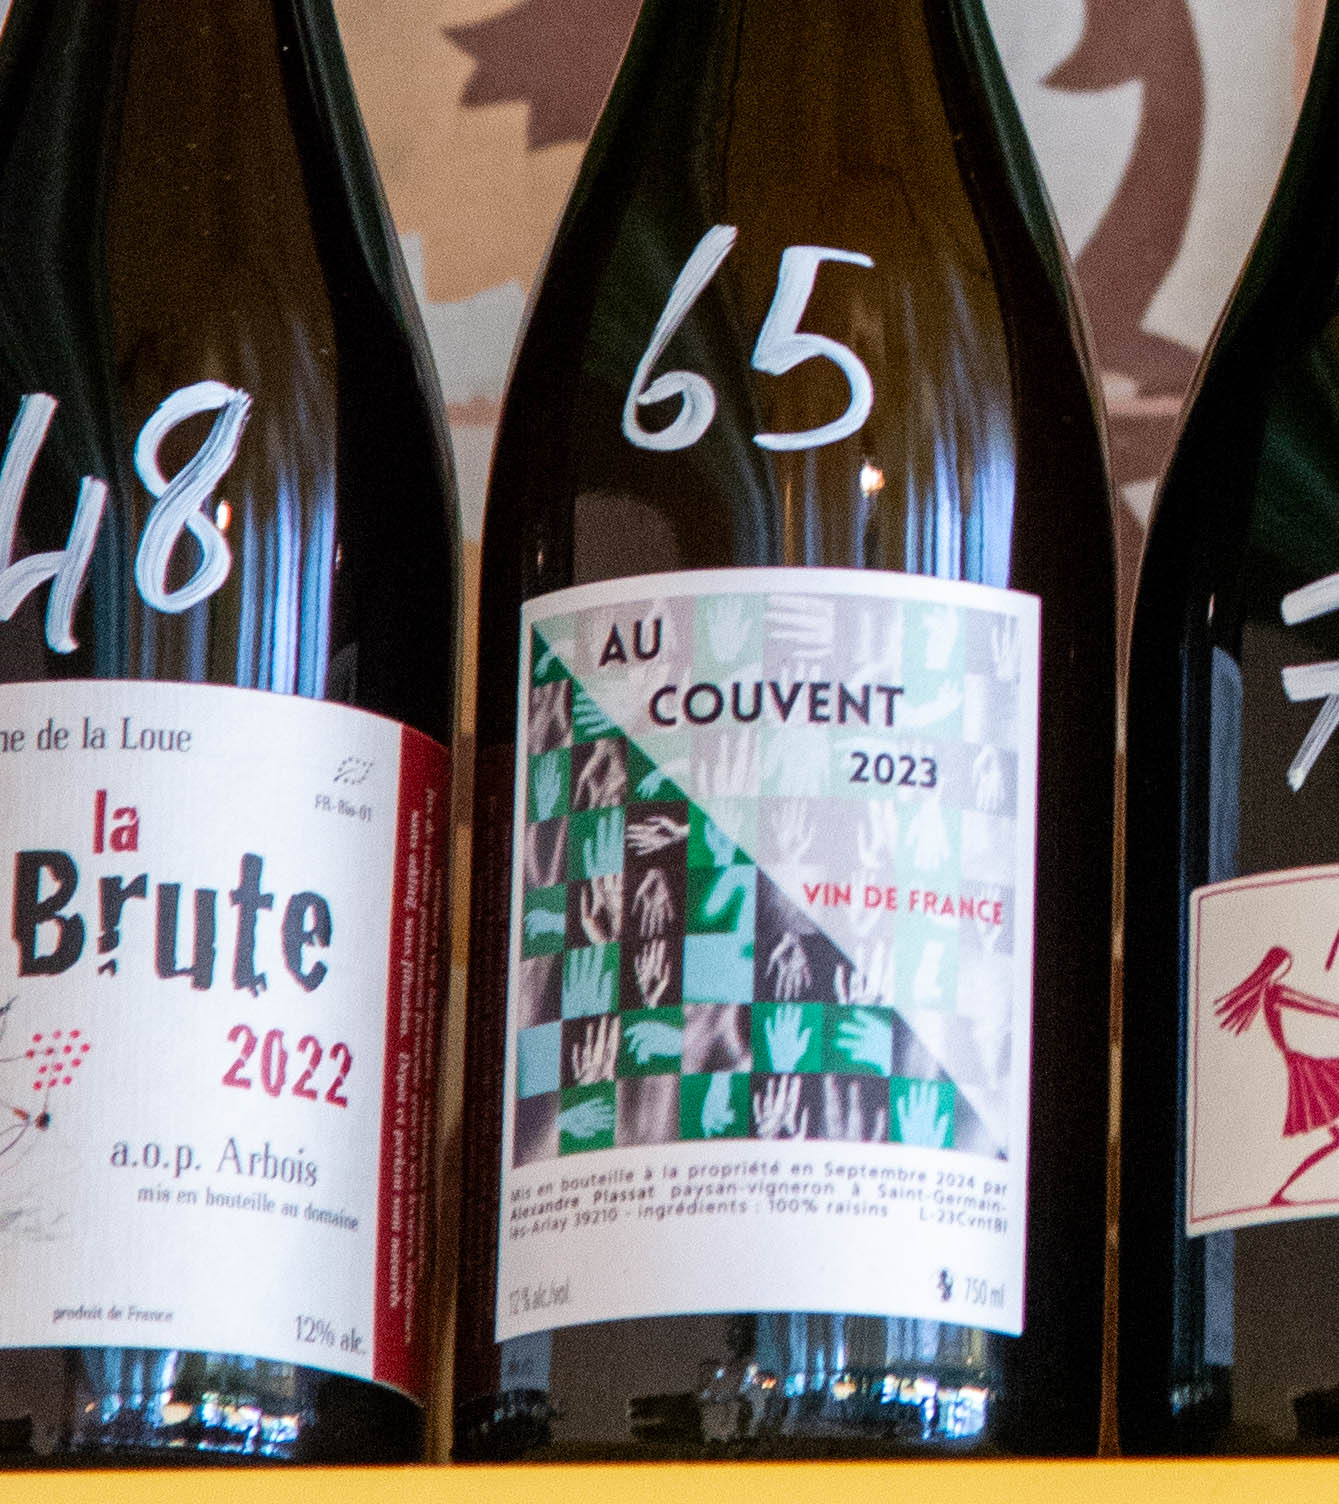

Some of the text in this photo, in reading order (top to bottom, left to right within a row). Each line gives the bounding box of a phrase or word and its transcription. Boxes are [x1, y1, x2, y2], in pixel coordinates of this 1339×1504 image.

[623, 224, 875, 452] 65
[0, 381, 252, 653] 48
[599, 618, 664, 668] AU
[648, 680, 905, 728] COUVENT
[37, 717, 69, 751] de
[82, 717, 106, 751] la
[119, 716, 193, 754] Loue
[848, 750, 939, 789] 2023
[92, 788, 140, 854] la
[12, 849, 334, 998] Brute
[803, 881, 1004, 926] VIN DE FRANCE
[221, 1023, 354, 1109] 2022
[110, 1136, 320, 1188] a.o.p. Arbois
[509, 1159, 1008, 1204] Mis en bouteille à la propriété en Septembre 2024 par
[137, 1183, 359, 1232] mis en bouteille au domaine
[509, 1196, 580, 1223] Alexandre
[593, 1184, 656, 1205] Plassat
[671, 1180, 835, 1201] paysan-vigneron
[851, 1181, 861, 1199] à
[574, 1205, 619, 1229] 39210
[637, 1198, 748, 1222] ingrédients
[768, 1198, 818, 1215] 100%
[826, 1199, 889, 1219] raisins
[52, 1304, 174, 1324] produit de France
[294, 1313, 336, 1347] 12%
